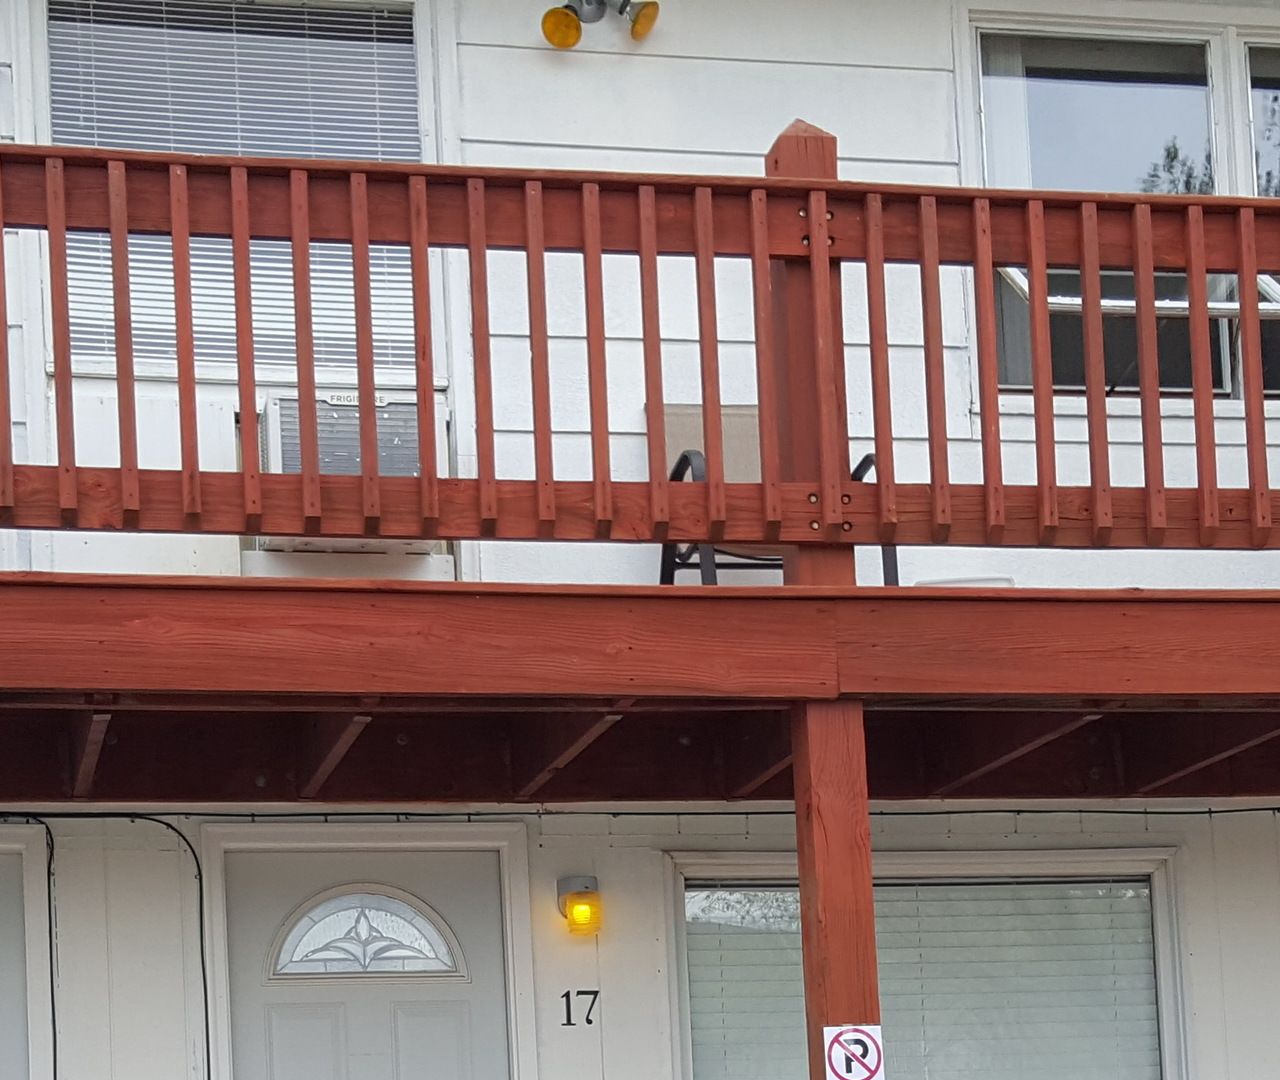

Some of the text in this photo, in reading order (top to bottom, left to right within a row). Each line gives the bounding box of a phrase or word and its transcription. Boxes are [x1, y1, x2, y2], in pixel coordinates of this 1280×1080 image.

[330, 395, 385, 404] FRIGIE
[560, 989, 600, 1027] 17
[843, 1038, 869, 1074] P
